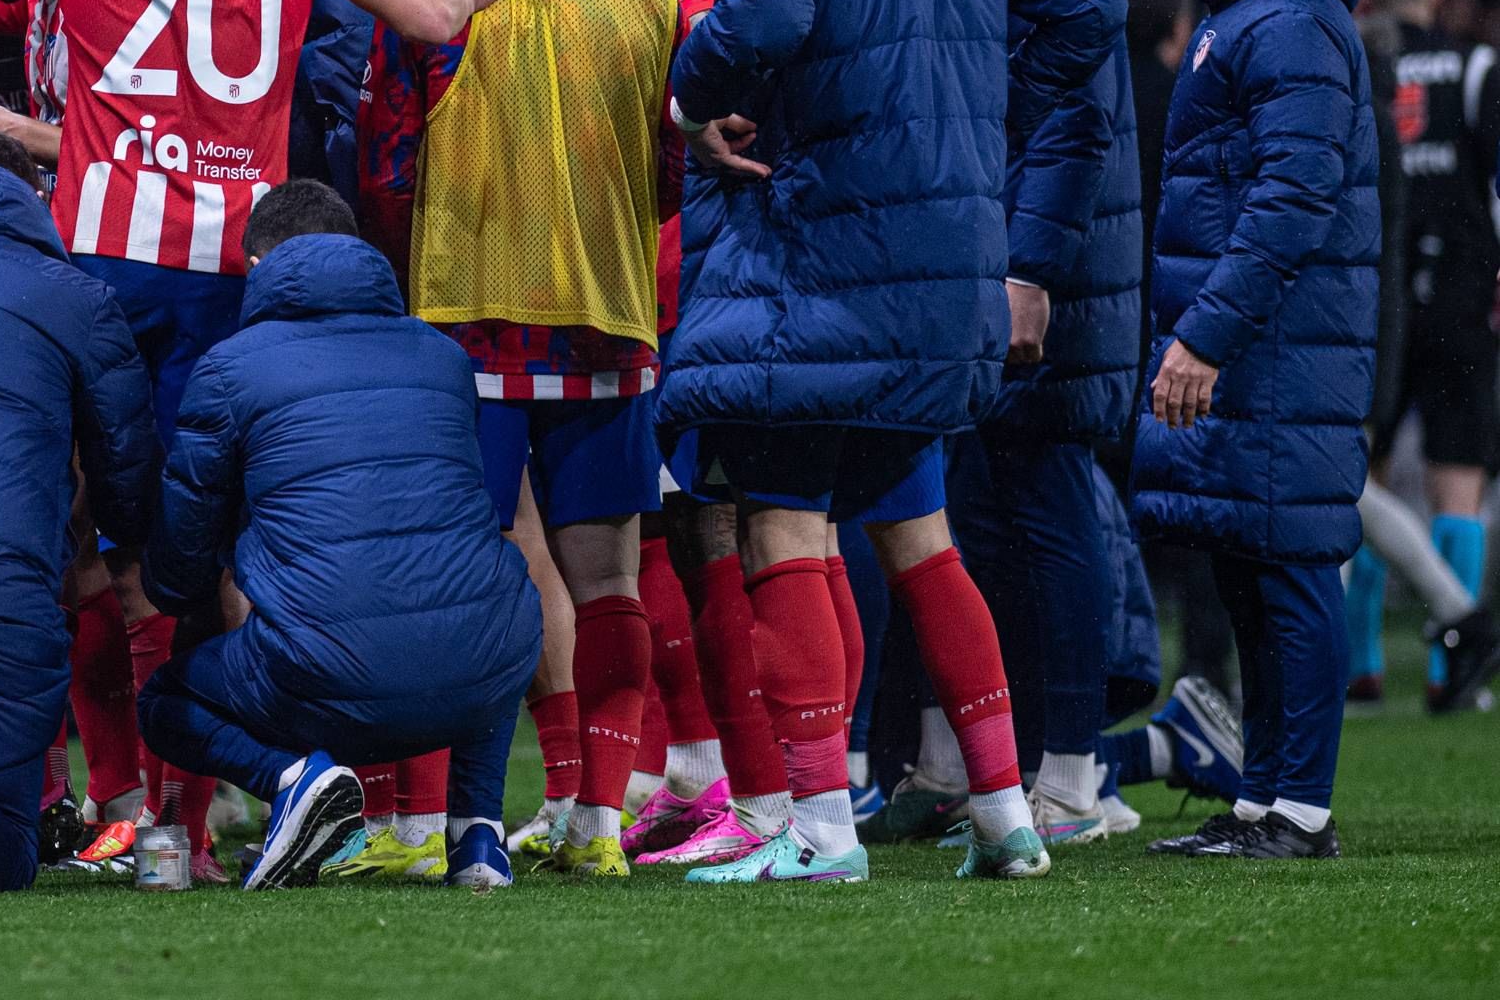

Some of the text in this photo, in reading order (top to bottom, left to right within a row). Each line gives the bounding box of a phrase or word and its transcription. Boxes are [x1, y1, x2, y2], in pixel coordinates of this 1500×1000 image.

[113, 114, 189, 173] ria
[196, 140, 254, 165] Money
[194, 159, 262, 181] Transfer
